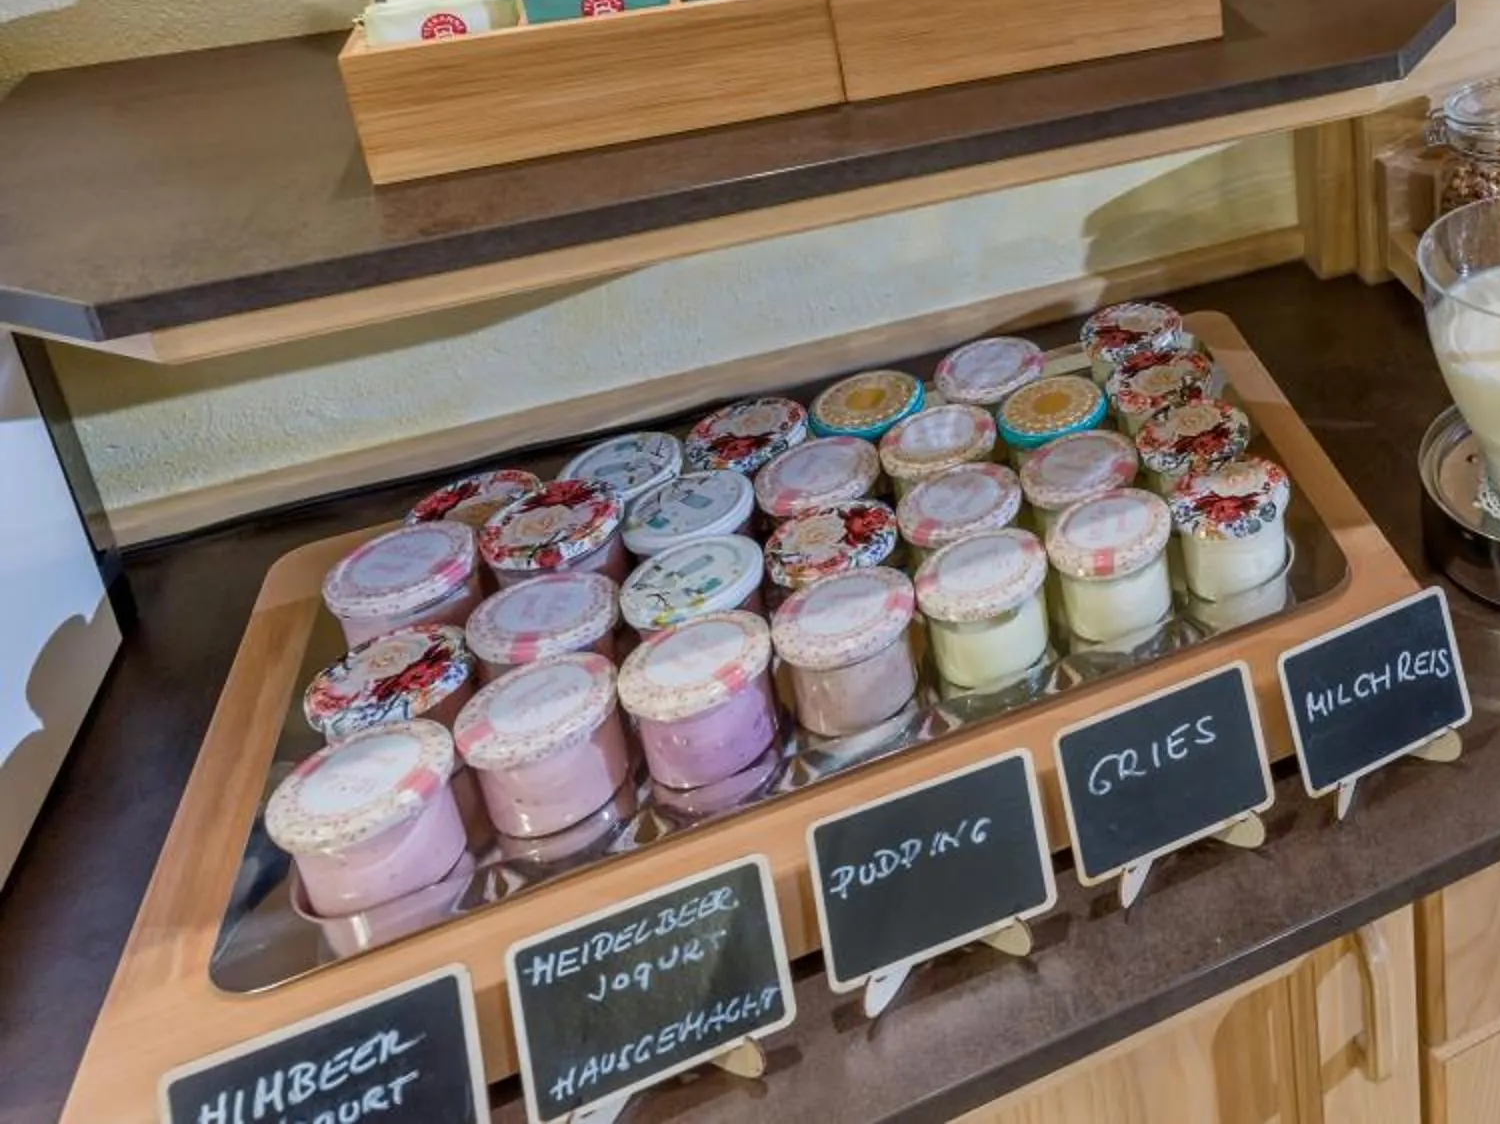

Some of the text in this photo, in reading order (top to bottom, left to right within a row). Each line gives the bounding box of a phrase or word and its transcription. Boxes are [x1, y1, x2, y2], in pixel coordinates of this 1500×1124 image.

[1305, 648, 1450, 724] MILCHREIS
[1088, 715, 1217, 796] GRIES
[829, 817, 992, 900] PUDDING
[198, 1029, 426, 1124] HIMBEER
